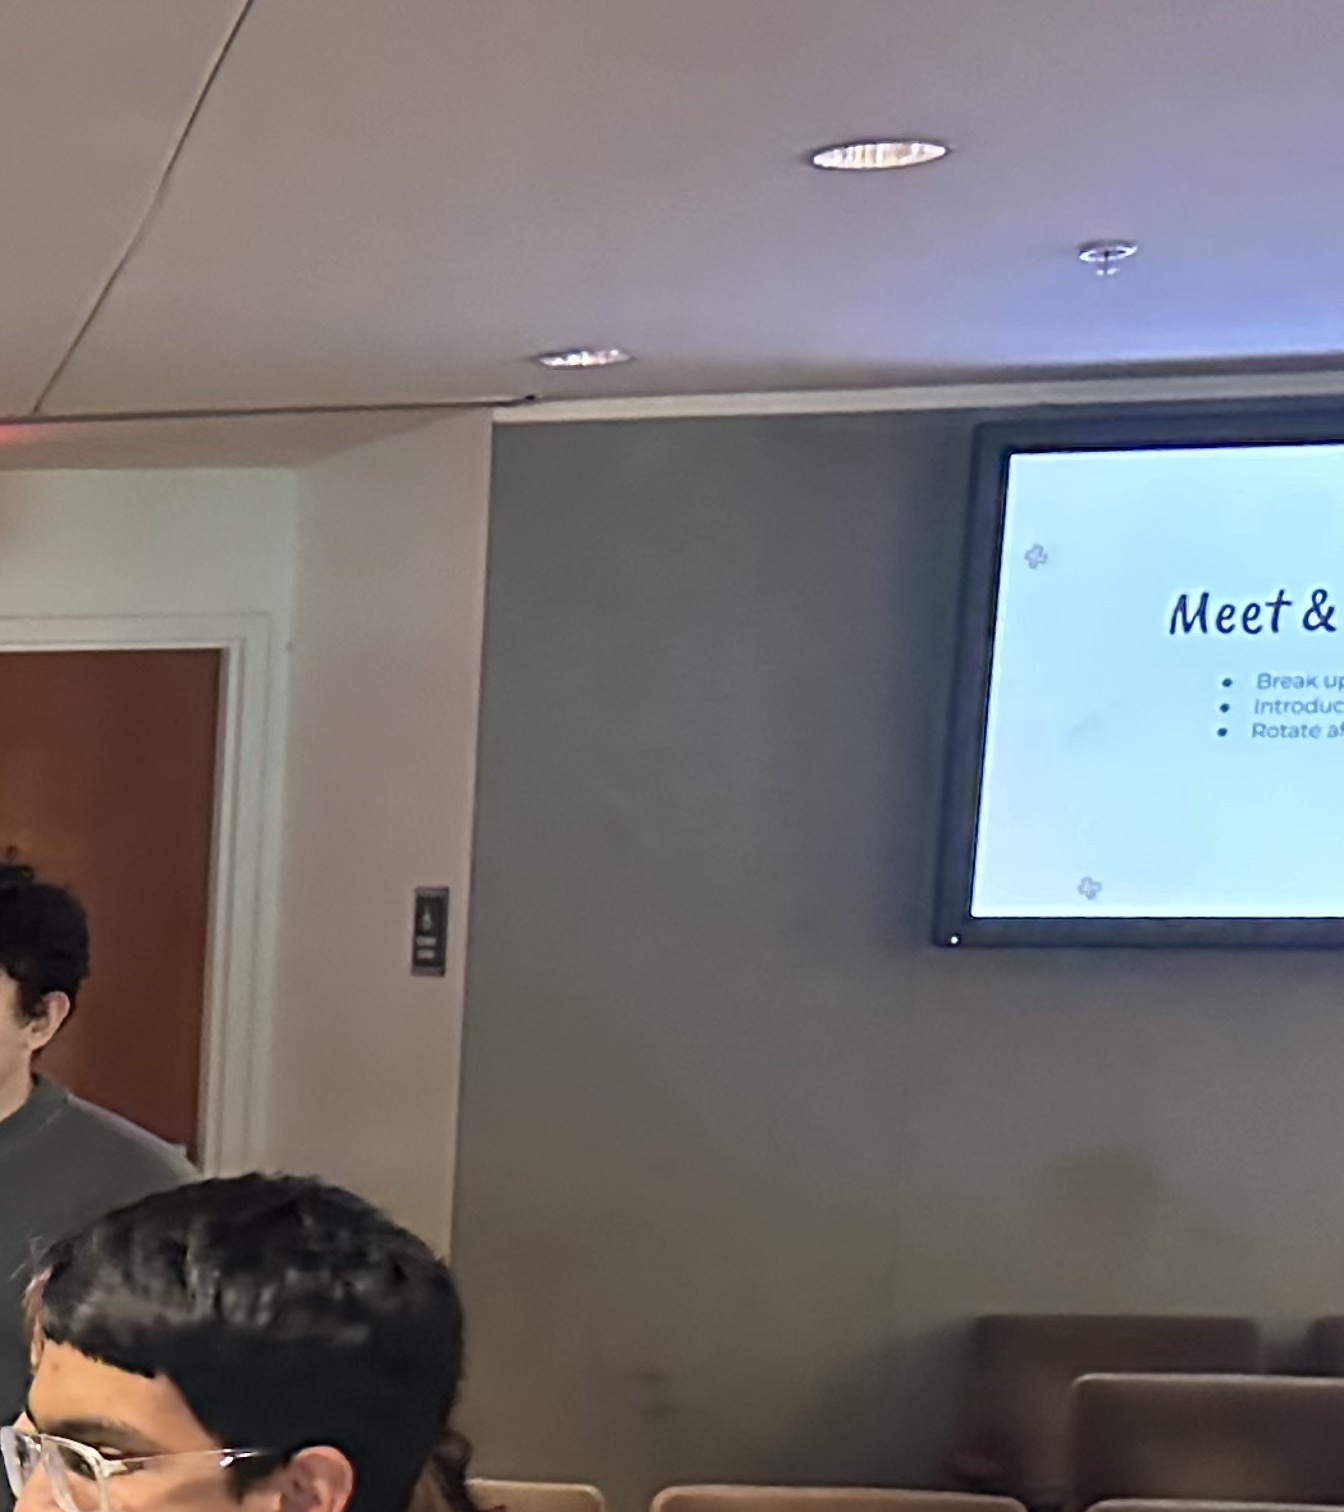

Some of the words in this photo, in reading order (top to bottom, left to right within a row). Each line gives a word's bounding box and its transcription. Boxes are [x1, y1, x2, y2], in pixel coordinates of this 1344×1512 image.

[1169, 588, 1293, 635] Meet
[1302, 588, 1337, 632] &
[1256, 672, 1318, 690] Break
[1251, 723, 1322, 739] Rotate
